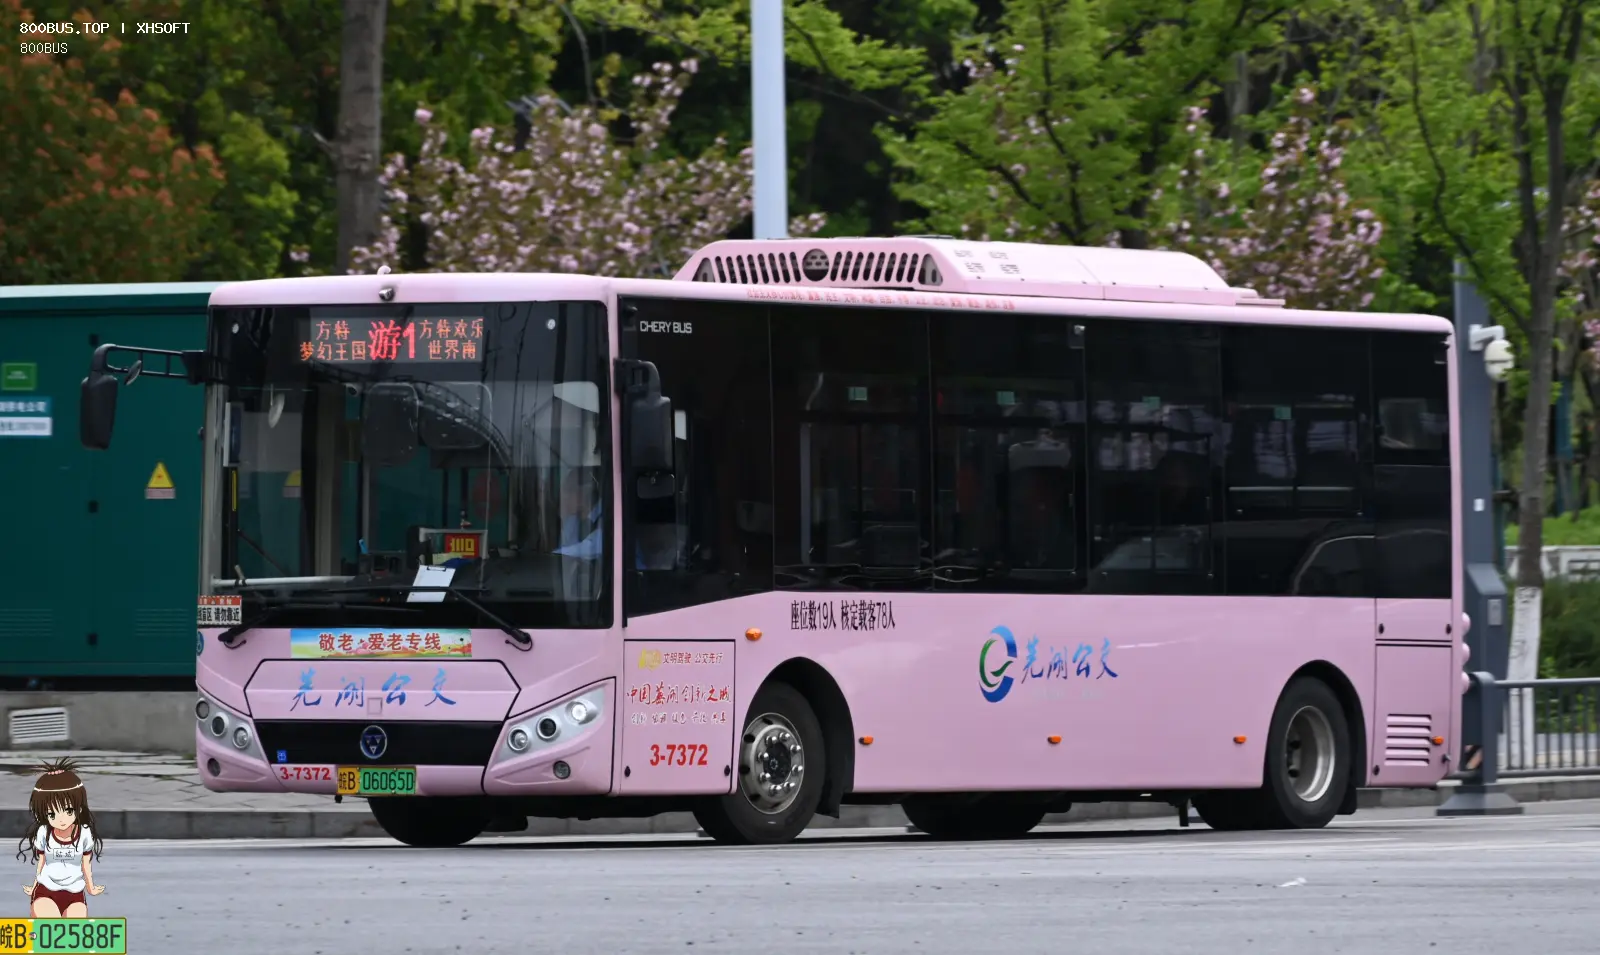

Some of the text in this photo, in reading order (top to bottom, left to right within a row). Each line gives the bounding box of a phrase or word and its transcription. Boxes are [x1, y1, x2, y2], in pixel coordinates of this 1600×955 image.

[316, 320, 350, 341] 方特
[419, 318, 484, 339] 方特欢乐
[640, 320, 692, 334] CHERY BUS
[368, 320, 415, 360] 游1
[428, 340, 476, 360] 世界南
[300, 341, 366, 361] 梦幻王国
[214, 607, 240, 622] 请勿靠近
[791, 600, 896, 631] 座位数19人 核定载客78人
[650, 744, 708, 767] 3-7372
[280, 767, 331, 780] 3-7372
